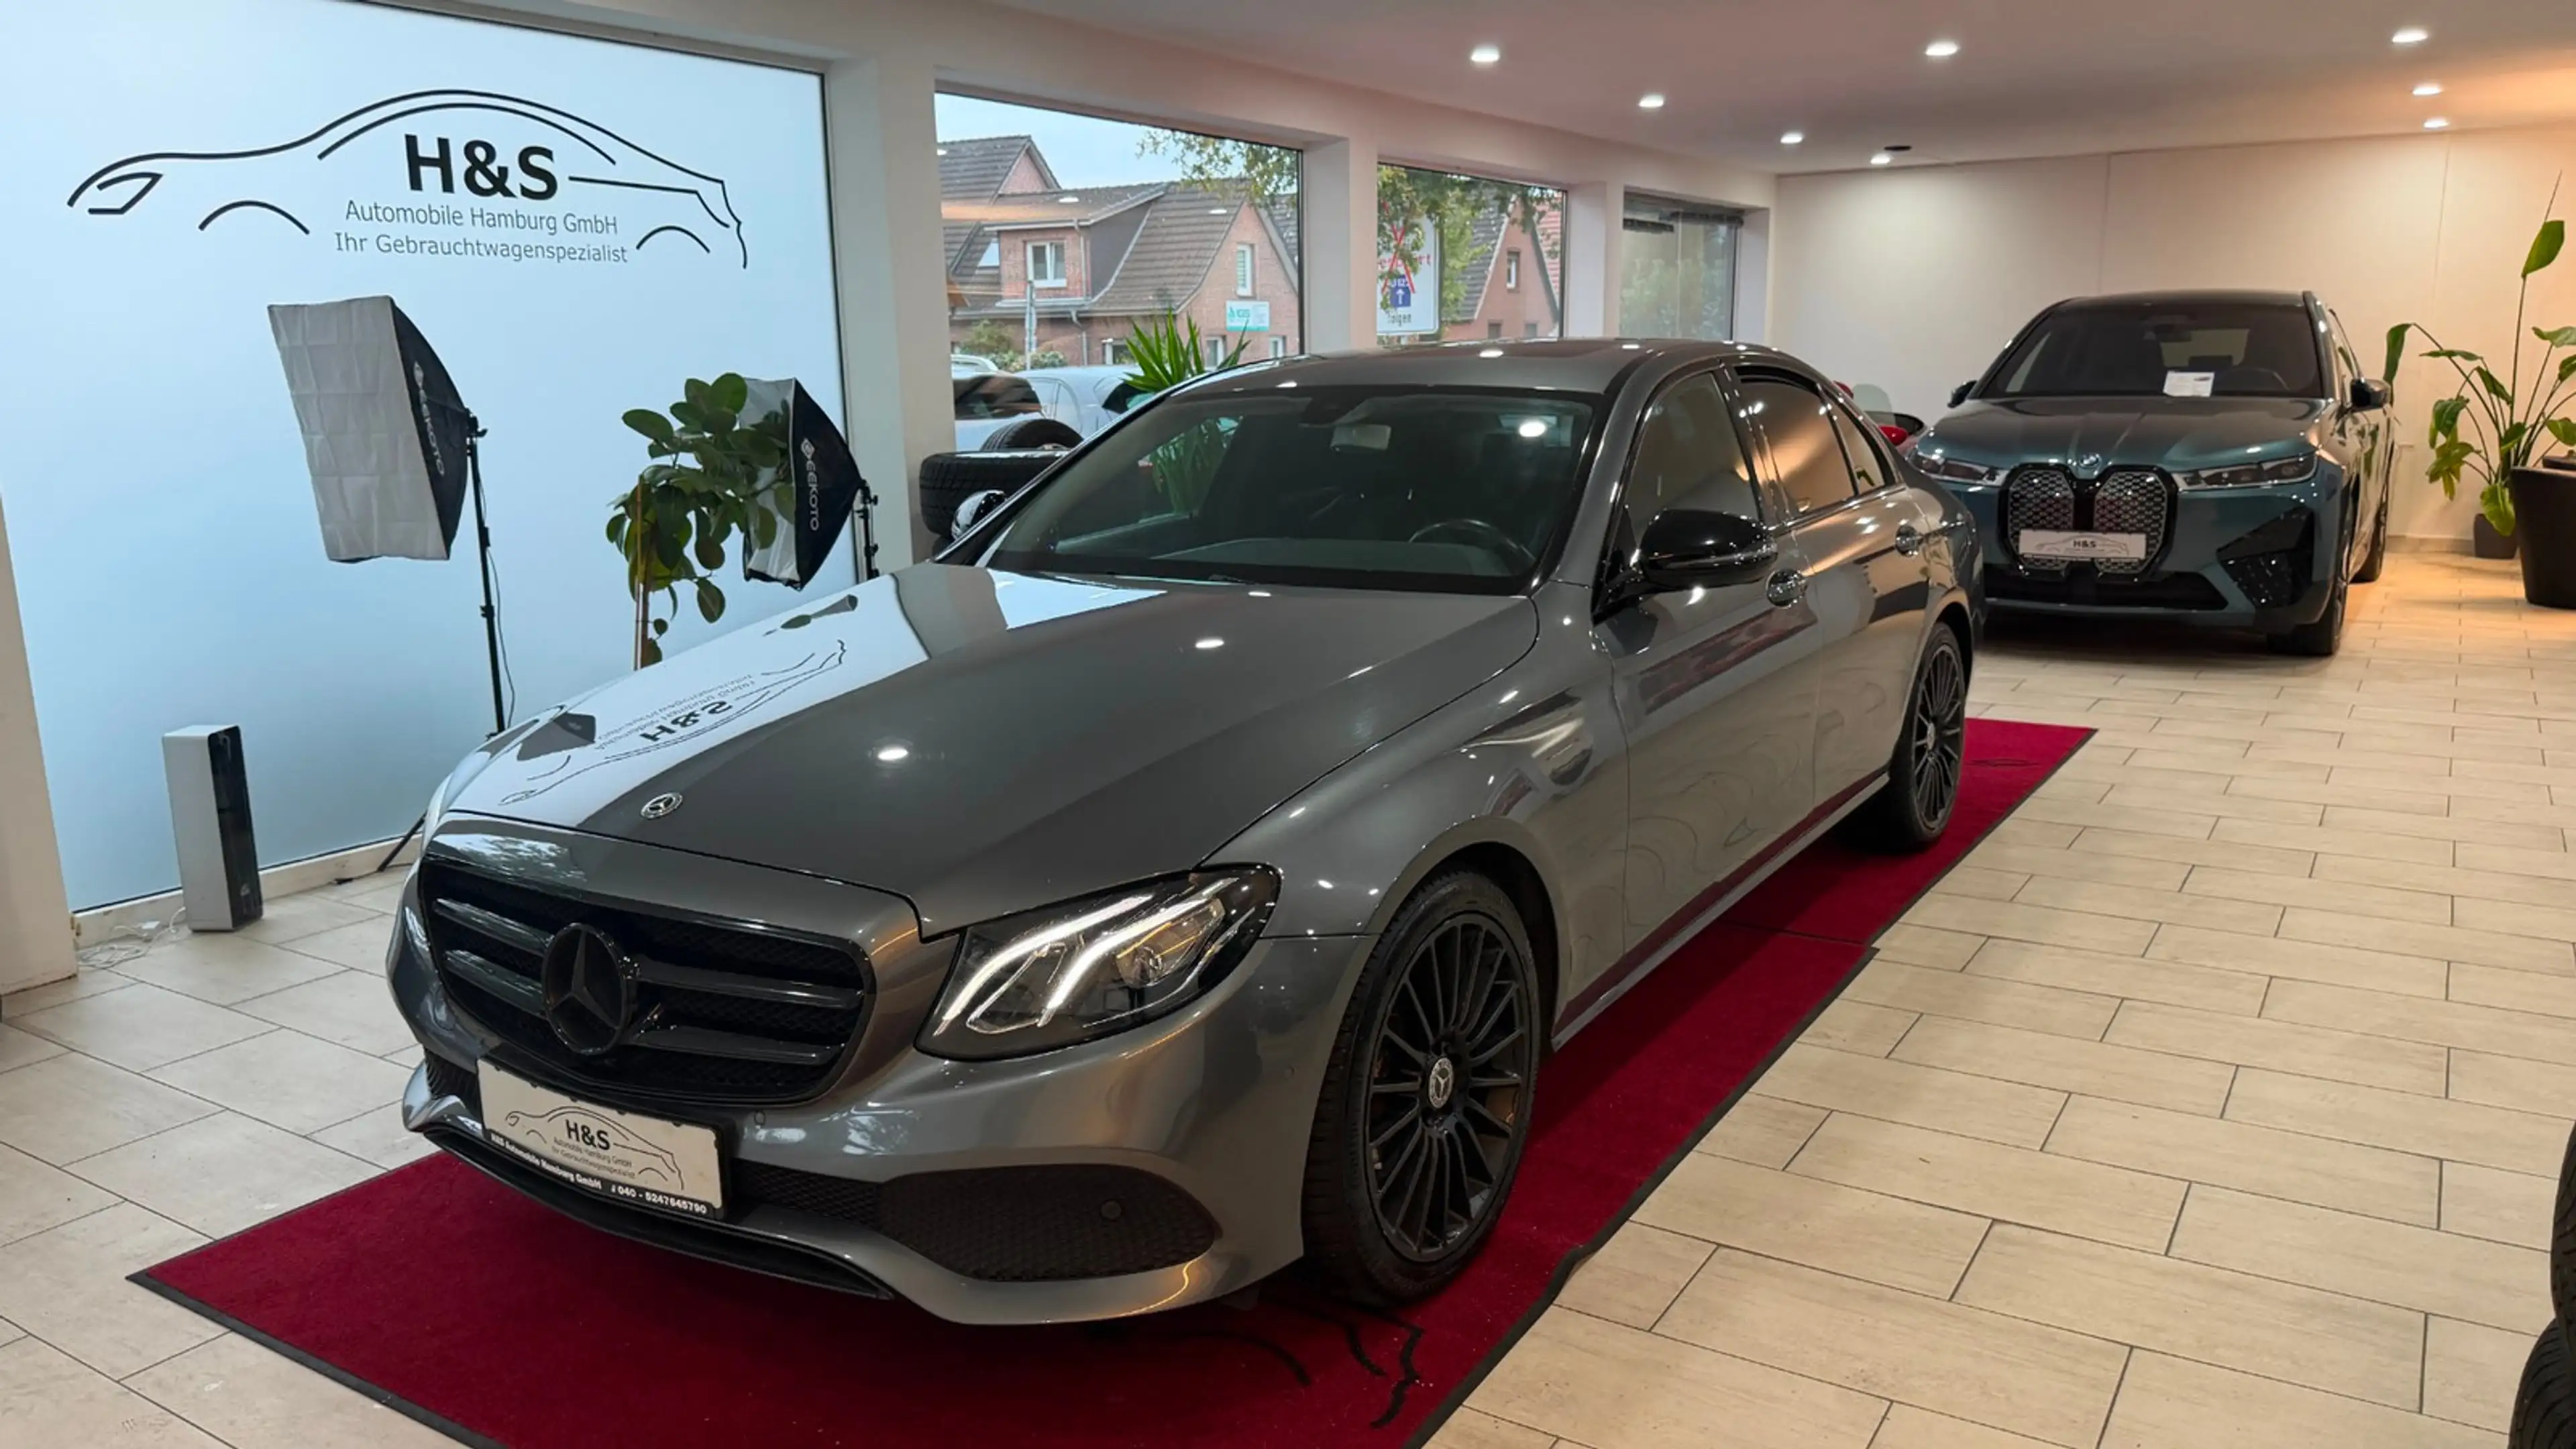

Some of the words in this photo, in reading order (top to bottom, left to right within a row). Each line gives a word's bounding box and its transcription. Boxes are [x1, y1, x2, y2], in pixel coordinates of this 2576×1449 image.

[405, 133, 558, 200] H&S
[345, 200, 464, 226] Automobile
[470, 208, 557, 235] Hamburg
[563, 213, 618, 235] GmbH
[335, 232, 368, 252] Ihr
[376, 234, 628, 263] Gebrauchtwagenspezialist
[566, 1119, 610, 1150] H&S
[575, 1173, 602, 1190] GmbH
[617, 1185, 637, 1198] 040
